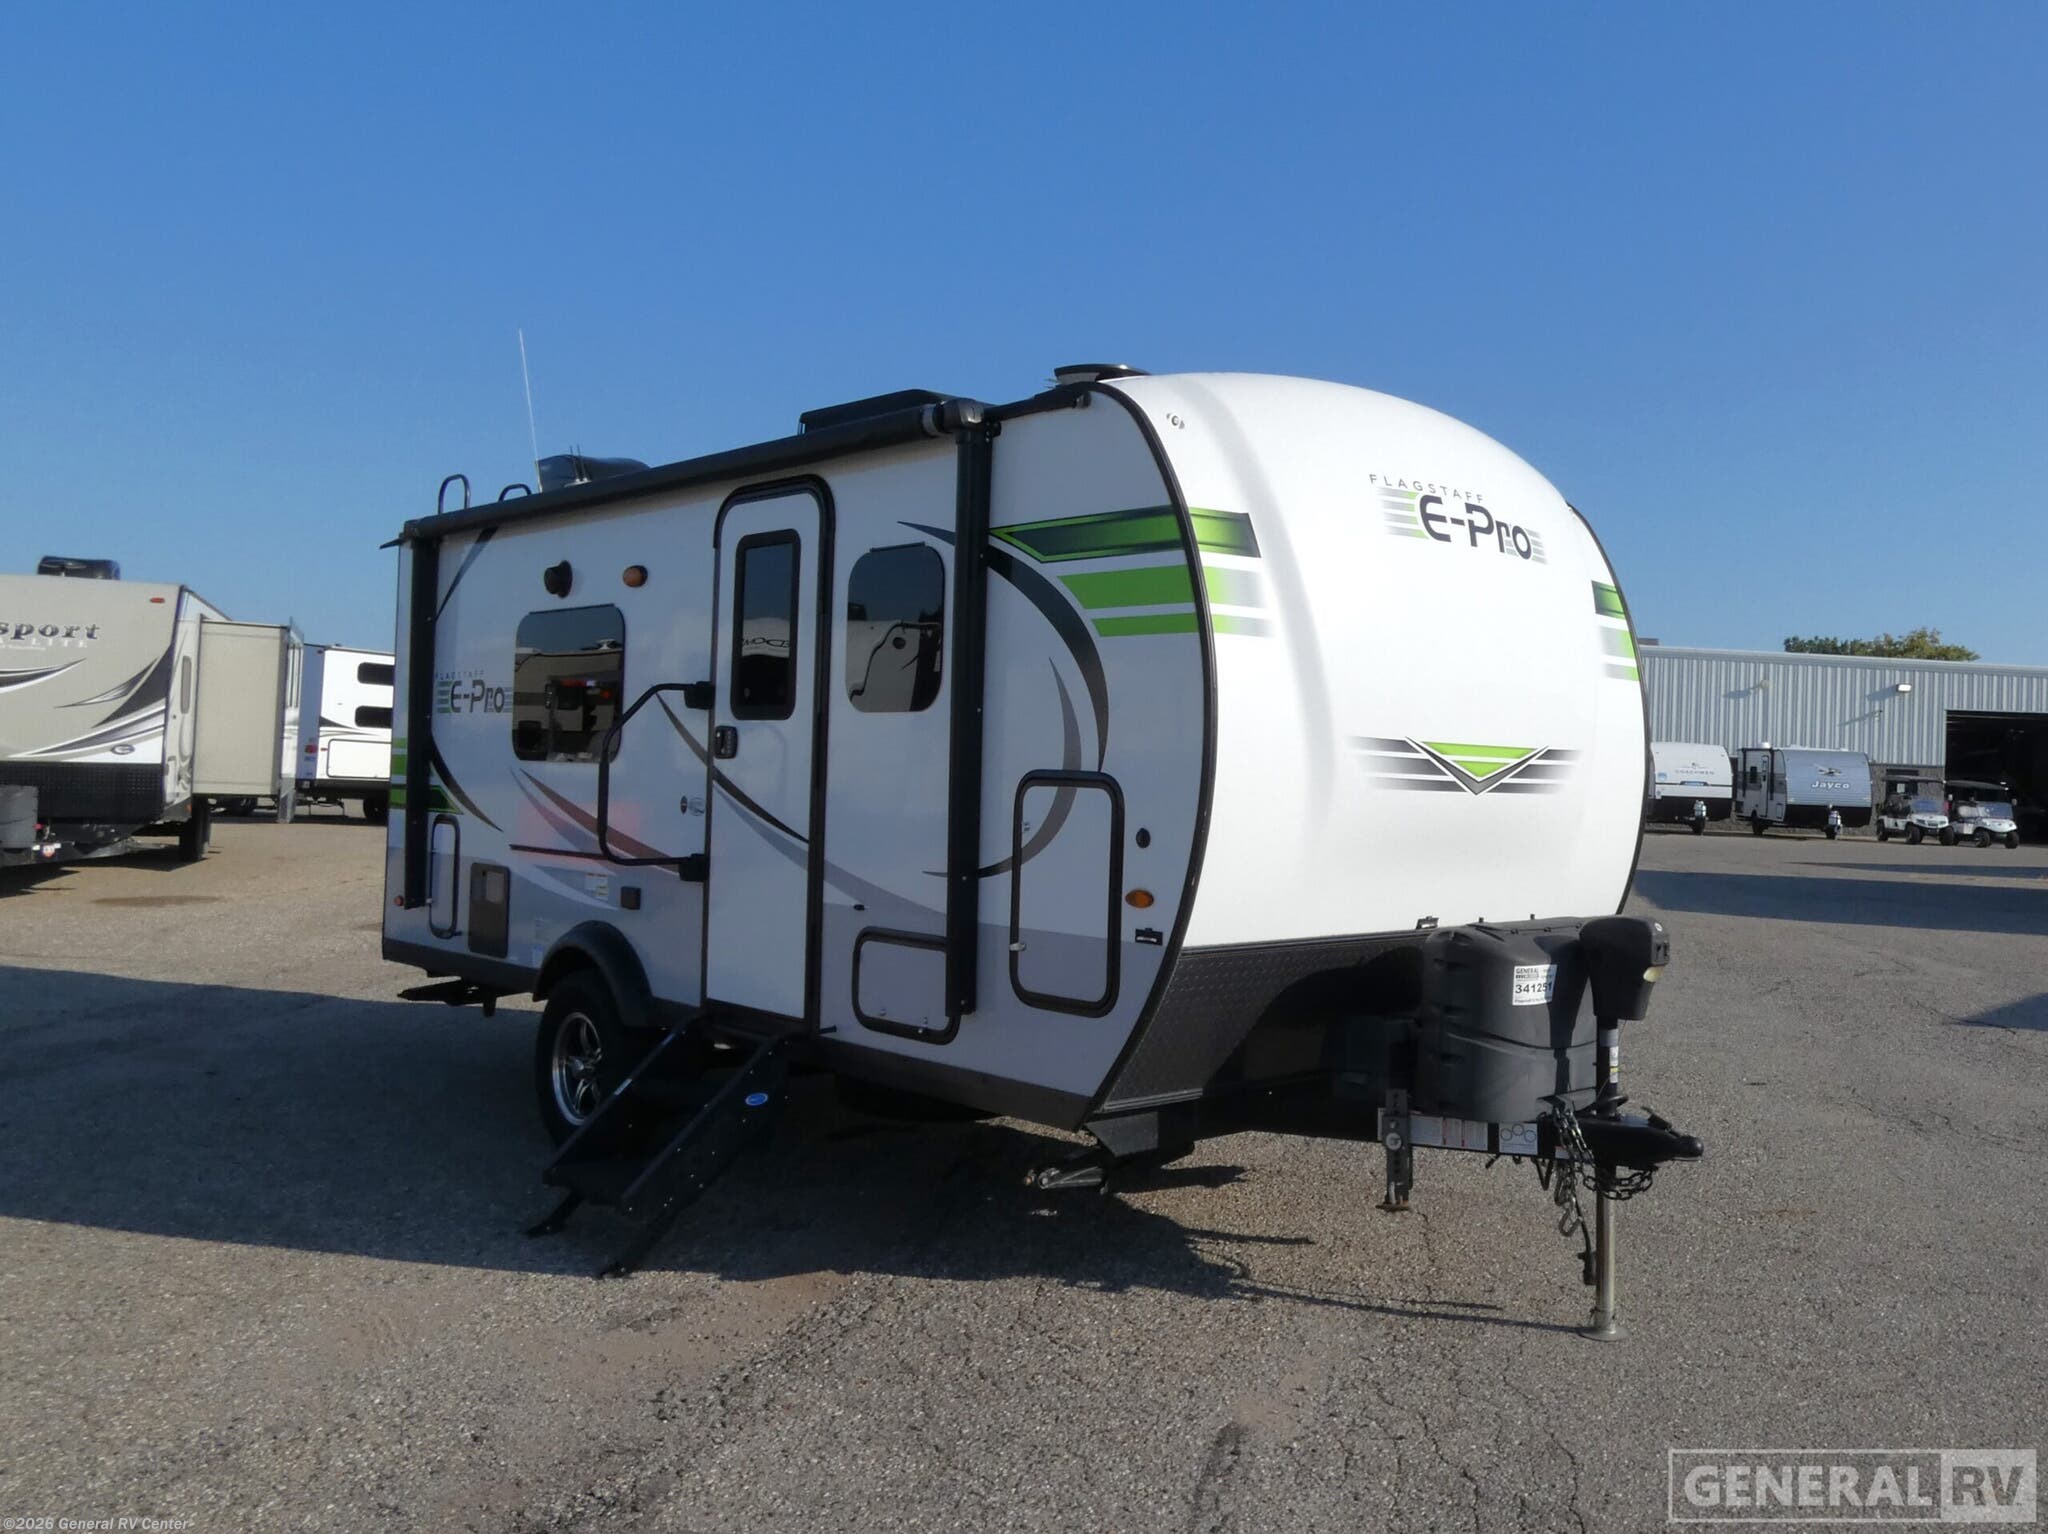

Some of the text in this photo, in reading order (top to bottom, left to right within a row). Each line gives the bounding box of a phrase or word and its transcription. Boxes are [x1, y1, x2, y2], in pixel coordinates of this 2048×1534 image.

[1368, 473, 1484, 503] FLAGSTAFF
[1420, 494, 1532, 560] E-Pro
[451, 680, 505, 713] E-Pro
[1811, 780, 1850, 790] Jayco
